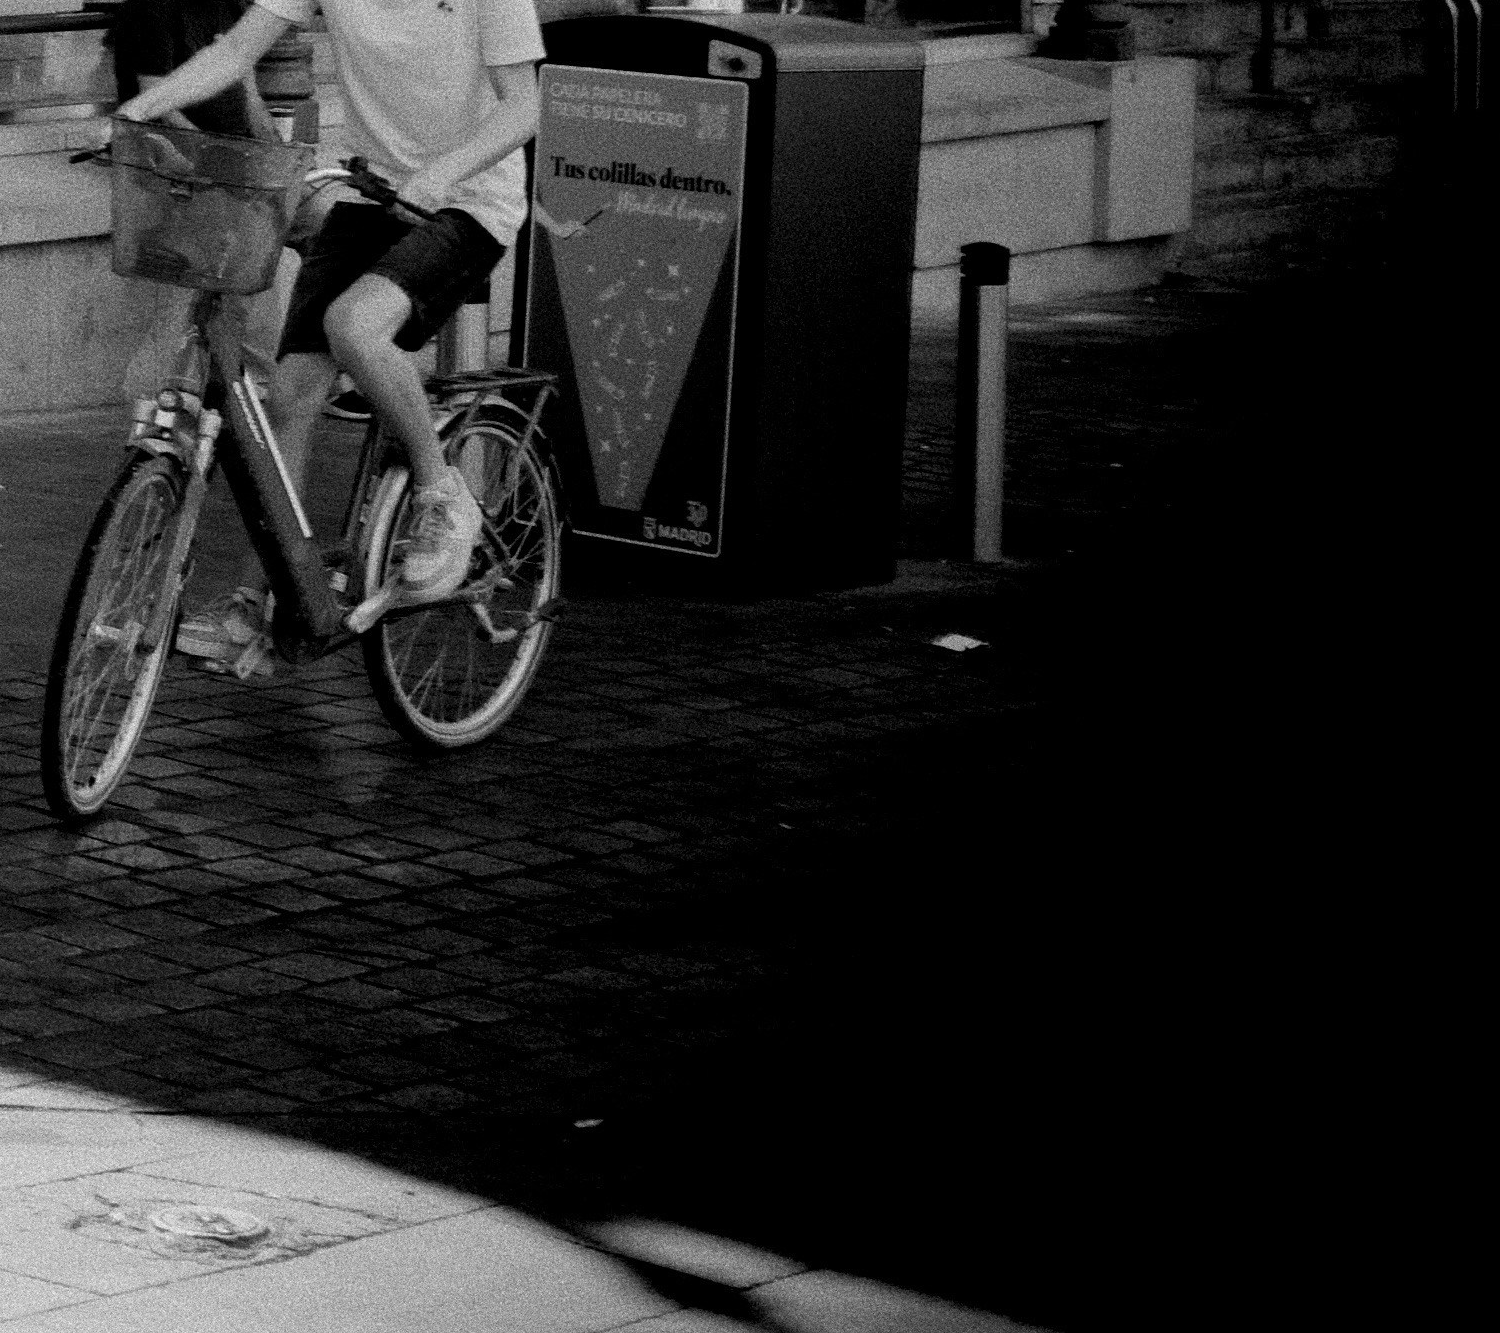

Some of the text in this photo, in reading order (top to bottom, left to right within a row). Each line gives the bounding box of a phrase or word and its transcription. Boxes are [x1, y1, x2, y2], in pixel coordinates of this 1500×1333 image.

[550, 155, 585, 180] Tus
[588, 161, 657, 187] colillas
[658, 523, 713, 548] MADRID
